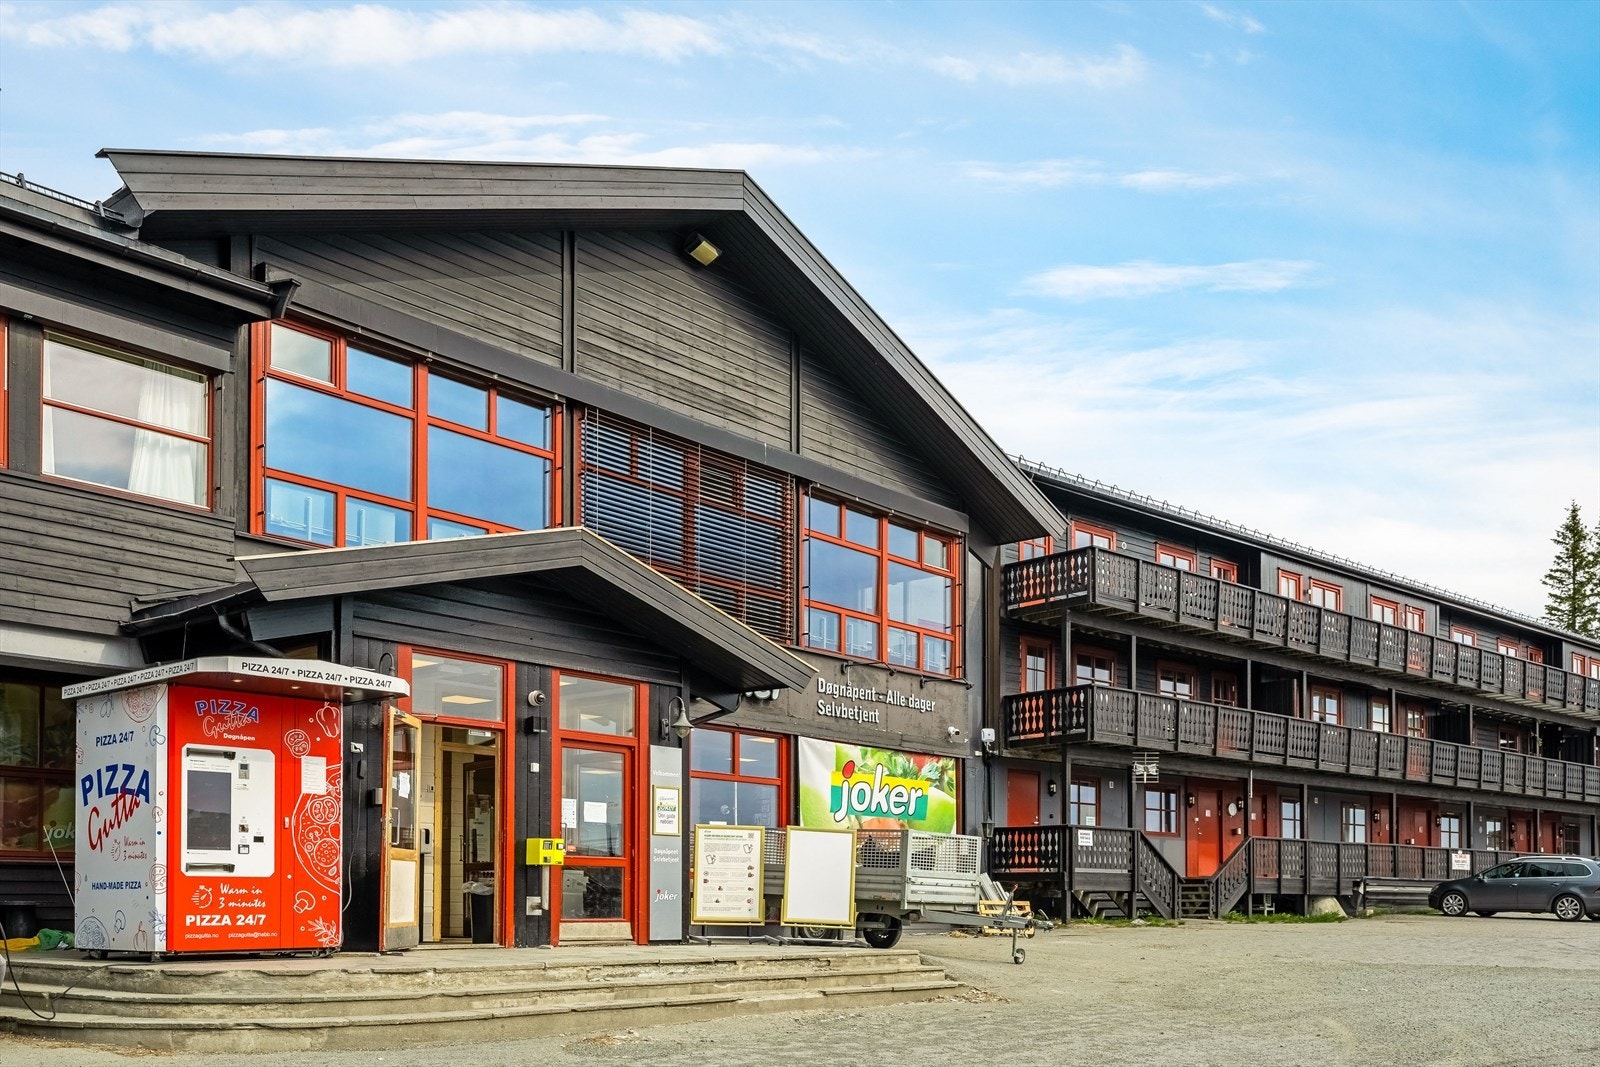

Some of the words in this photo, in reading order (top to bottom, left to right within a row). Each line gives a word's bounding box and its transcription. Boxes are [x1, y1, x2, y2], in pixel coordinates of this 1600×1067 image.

[64, 687, 76, 696] PIZZA
[88, 682, 101, 693] PIZZA
[113, 677, 127, 686] PIZZA
[127, 674, 137, 684] 24/7
[140, 670, 155, 680] PIZZA
[155, 667, 165, 678] 24/7
[168, 665, 183, 675] PIZZA
[183, 662, 195, 672] 24/7
[241, 662, 269, 674] PIZZA
[271, 666, 290, 676] 24/7
[297, 669, 324, 680] PIZZA
[325, 672, 343, 682] 24/7
[349, 676, 374, 687] PIZZA
[375, 679, 392, 688] 24/7
[817, 677, 876, 703] Døgnåpent
[886, 689, 907, 707] Alle
[908, 694, 936, 713] dager
[194, 699, 259, 724] PIZZA
[817, 699, 880, 724] Selvbetjent
[202, 710, 252, 739] Gutta
[95, 734, 117, 747] PIZZA
[118, 731, 135, 744] 24/7
[80, 763, 150, 807] PIZZA
[833, 760, 923, 823] joker
[88, 786, 141, 853] Gutta
[91, 881, 124, 890] HAND-MADE
[124, 881, 141, 890] PIZZA
[220, 882, 249, 894] Warm
[251, 885, 263, 894] in
[655, 889, 678, 902] joker
[218, 897, 225, 909] 3
[228, 898, 266, 908] minutes
[185, 914, 232, 926] PIZZA
[236, 914, 267, 926] 24/7
